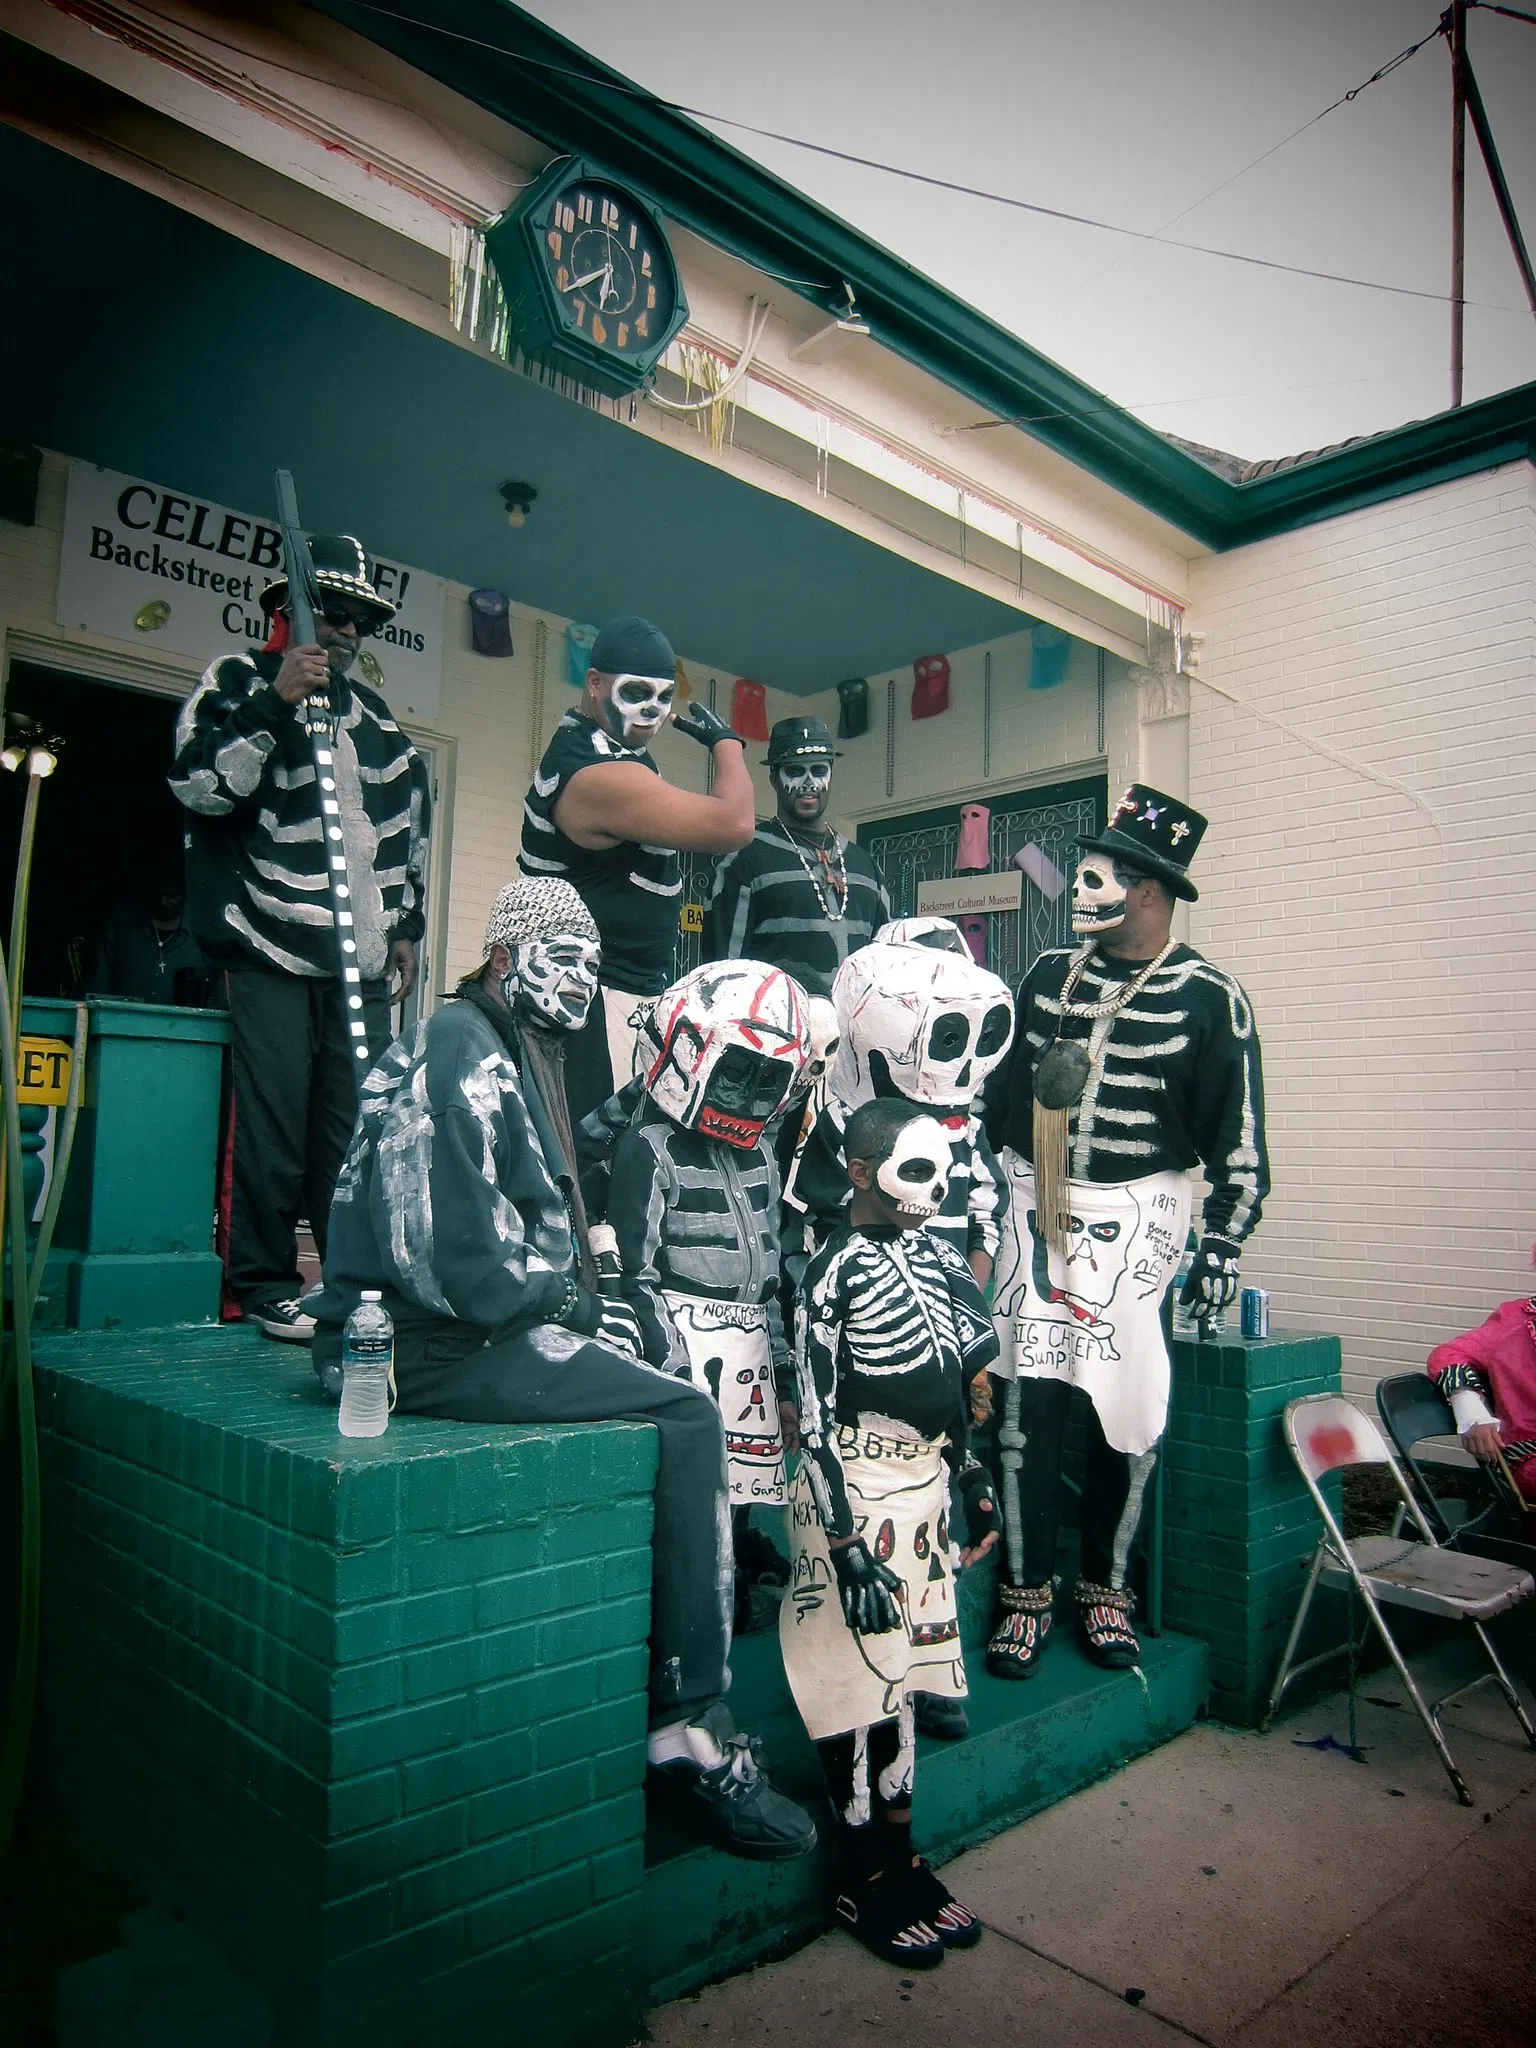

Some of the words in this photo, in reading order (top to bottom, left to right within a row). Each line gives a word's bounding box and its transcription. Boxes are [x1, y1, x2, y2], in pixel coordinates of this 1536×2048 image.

[554, 201, 575, 234] 10
[577, 193, 593, 225] 11
[601, 198, 620, 231] 12
[547, 231, 563, 261] 9
[629, 224, 638, 250] 1
[641, 250, 652, 278] 2
[556, 266, 569, 292] 8
[646, 284, 656, 309] 3
[573, 298, 586, 328] 7
[634, 311, 648, 337] 4
[592, 313, 607, 344] 6
[617, 321, 630, 348] 5
[89, 526, 255, 602] Backstreet
[920, 901, 956, 913] Backstreet
[957, 896, 986, 909] Cultural
[988, 895, 1018, 906] Museum
[1152, 1193, 1177, 1216] 1819
[1147, 1221, 1173, 1240] Bones
[703, 1303, 750, 1321] NORTH
[718, 1315, 755, 1326] SKULL
[751, 1478, 784, 1502] Gang
